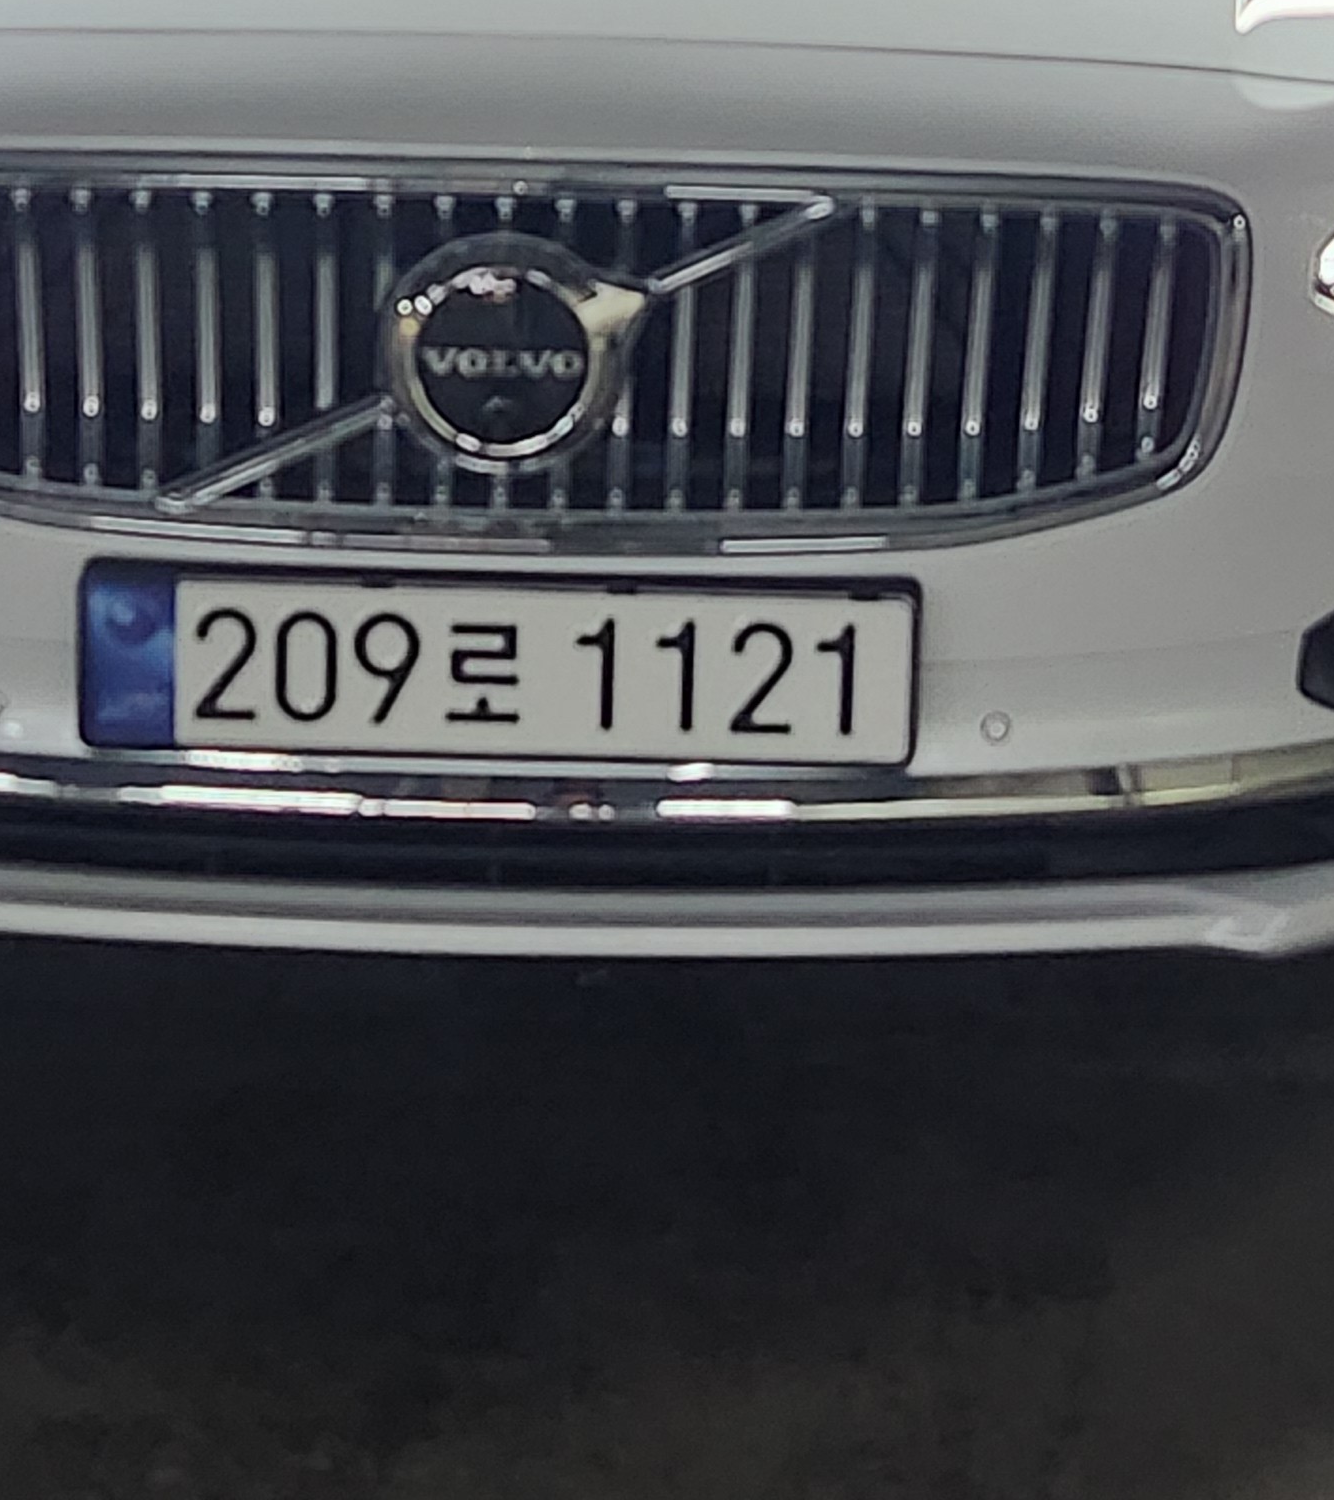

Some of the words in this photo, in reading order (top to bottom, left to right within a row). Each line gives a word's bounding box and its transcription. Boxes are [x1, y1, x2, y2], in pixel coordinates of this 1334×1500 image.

[422, 346, 584, 378] VOLVO
[191, 606, 522, 726] 209로
[574, 617, 858, 737] 1121
